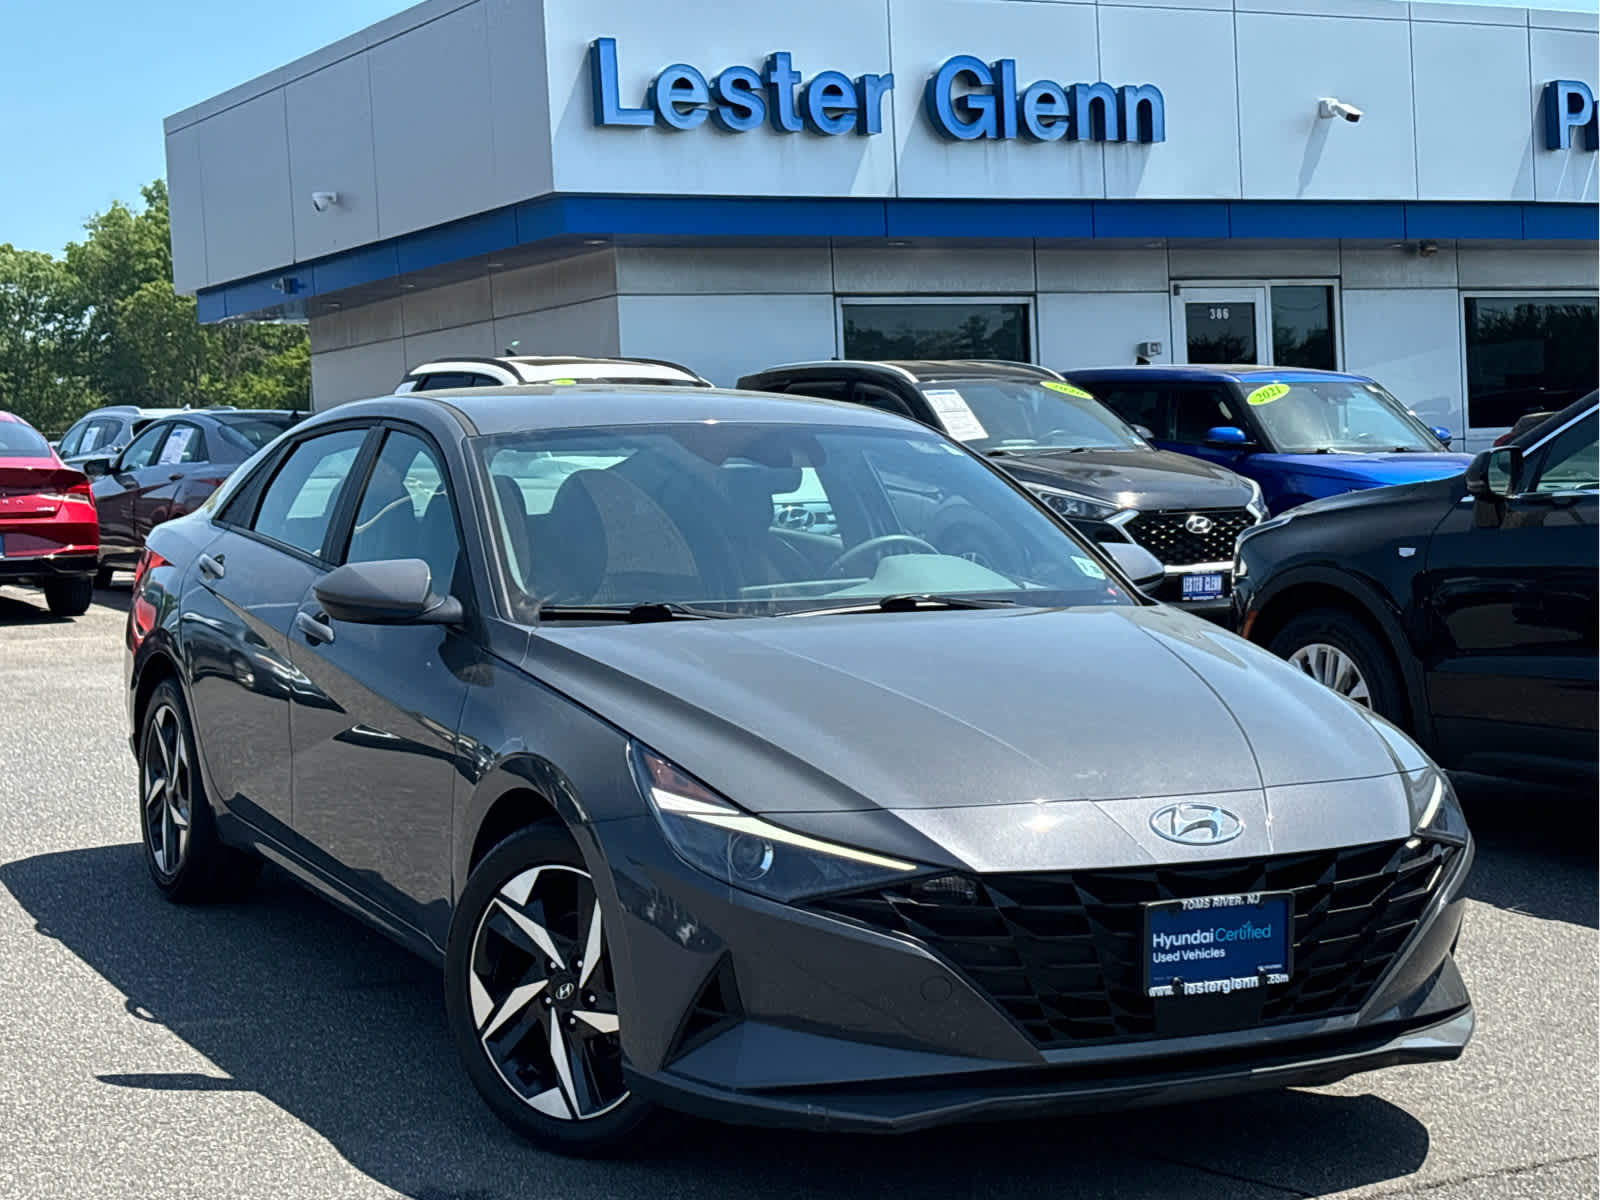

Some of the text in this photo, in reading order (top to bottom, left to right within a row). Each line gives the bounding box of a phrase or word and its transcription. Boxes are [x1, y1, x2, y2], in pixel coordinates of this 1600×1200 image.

[589, 37, 1166, 143] Lester Glenn
[1209, 308, 1229, 319] 386
[1255, 385, 1281, 402] 2021
[1182, 897, 1210, 910] TOMS
[1246, 893, 1261, 906] NJ
[1153, 922, 1272, 949] Hyundai Certified
[1153, 947, 1226, 963] Used Vehicles
[1183, 975, 1259, 995] lesterglenn
